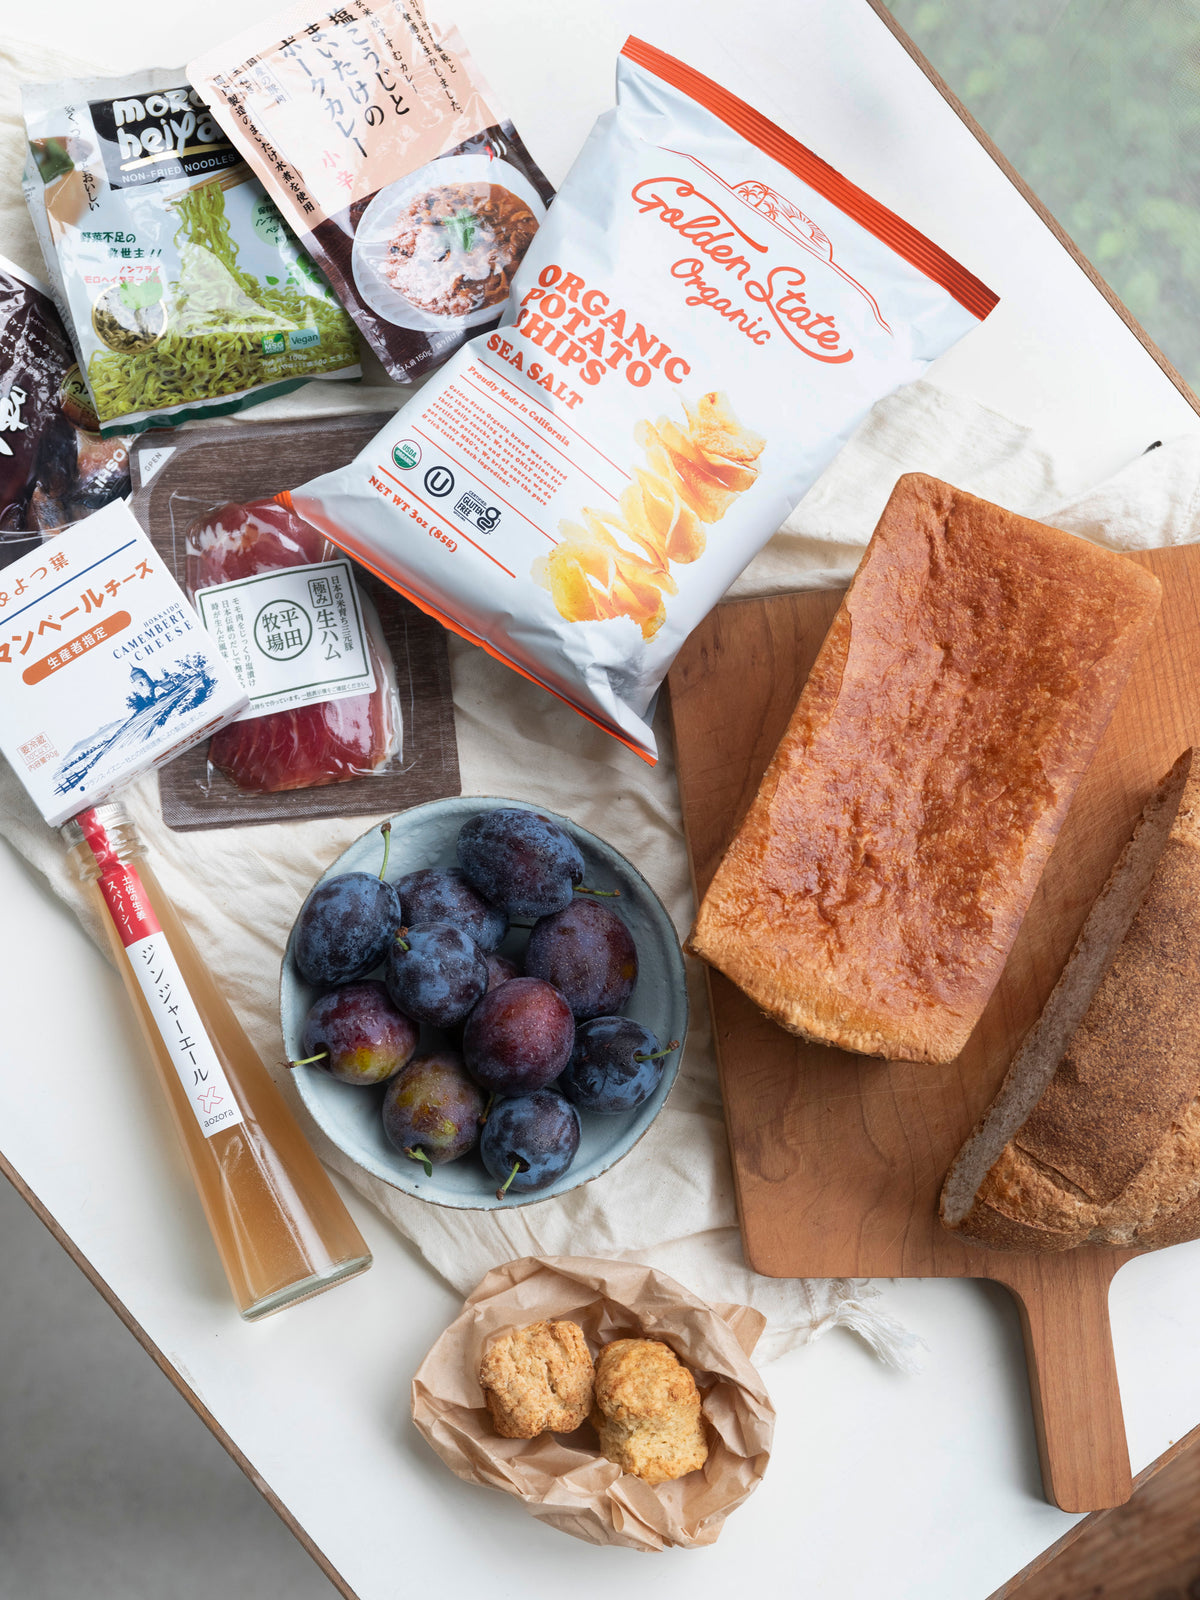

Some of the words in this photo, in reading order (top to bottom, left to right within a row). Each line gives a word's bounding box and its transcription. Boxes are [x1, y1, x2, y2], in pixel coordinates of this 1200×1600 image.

[304, 22, 385, 127] まいたけの
[326, 8, 410, 115] 塩こうじと
[278, 35, 367, 158] ポークカレー
[121, 165, 182, 184] NON-FRIED
[184, 153, 235, 173] NOODLES
[321, 149, 355, 190] 小辛
[631, 176, 769, 281] Golden
[744, 266, 854, 364] State
[538, 264, 691, 384] ORGANIC
[670, 257, 771, 346] Organic
[290, 333, 319, 345] Vegan
[519, 287, 652, 388] POTATO
[486, 333, 525, 372] SEA
[526, 362, 584, 410] SALT
[467, 365, 500, 392] Proudly
[498, 389, 520, 406] Made
[518, 403, 529, 413] In
[528, 410, 571, 447] California
[144, 452, 163, 472] OPEN
[402, 443, 417, 459] USDA
[427, 408, 438, 418] not
[437, 416, 448, 426] use
[448, 425, 460, 435] any
[491, 458, 509, 476] bring
[508, 474, 521, 484] out
[520, 483, 532, 494] the
[531, 492, 547, 506] pure
[437, 396, 454, 409] their
[453, 408, 469, 422] daily
[469, 421, 491, 440] snacks.
[503, 448, 515, 458] use
[514, 456, 534, 473] ONLY
[533, 472, 557, 493] organic
[440, 428, 456, 442] taste
[463, 447, 477, 460] each
[477, 458, 511, 488] ingredient.
[443, 390, 454, 400] for
[454, 398, 472, 414] those
[472, 413, 498, 435] seeking
[504, 437, 526, 457] better
[526, 457, 550, 477] option
[550, 475, 562, 486] for
[469, 400, 486, 415] State
[486, 413, 510, 434] Organic
[510, 432, 531, 450] brand
[530, 448, 543, 461] was
[543, 460, 568, 481] created
[488, 447, 502, 458] and
[509, 464, 532, 483] course
[368, 475, 393, 497] NET
[392, 494, 411, 513] WT
[408, 508, 429, 529] 3oz
[428, 526, 458, 553] (85g)
[457, 502, 472, 517] FREE
[462, 496, 485, 516] GLUTEN
[14, 551, 70, 596] よつ葉
[311, 581, 329, 606] 極み
[112, 608, 185, 660] CAMEMBERT
[134, 619, 194, 661] CHEESE
[143, 602, 180, 628] HOKKAIDO
[315, 608, 343, 662] 生ハム
[46, 625, 109, 671] 生産者指定
[107, 880, 134, 935] スパイシー
[121, 874, 148, 922] 土佐の生姜
[142, 944, 209, 1087] ジンジャーエール
[203, 1107, 235, 1128] aozora
